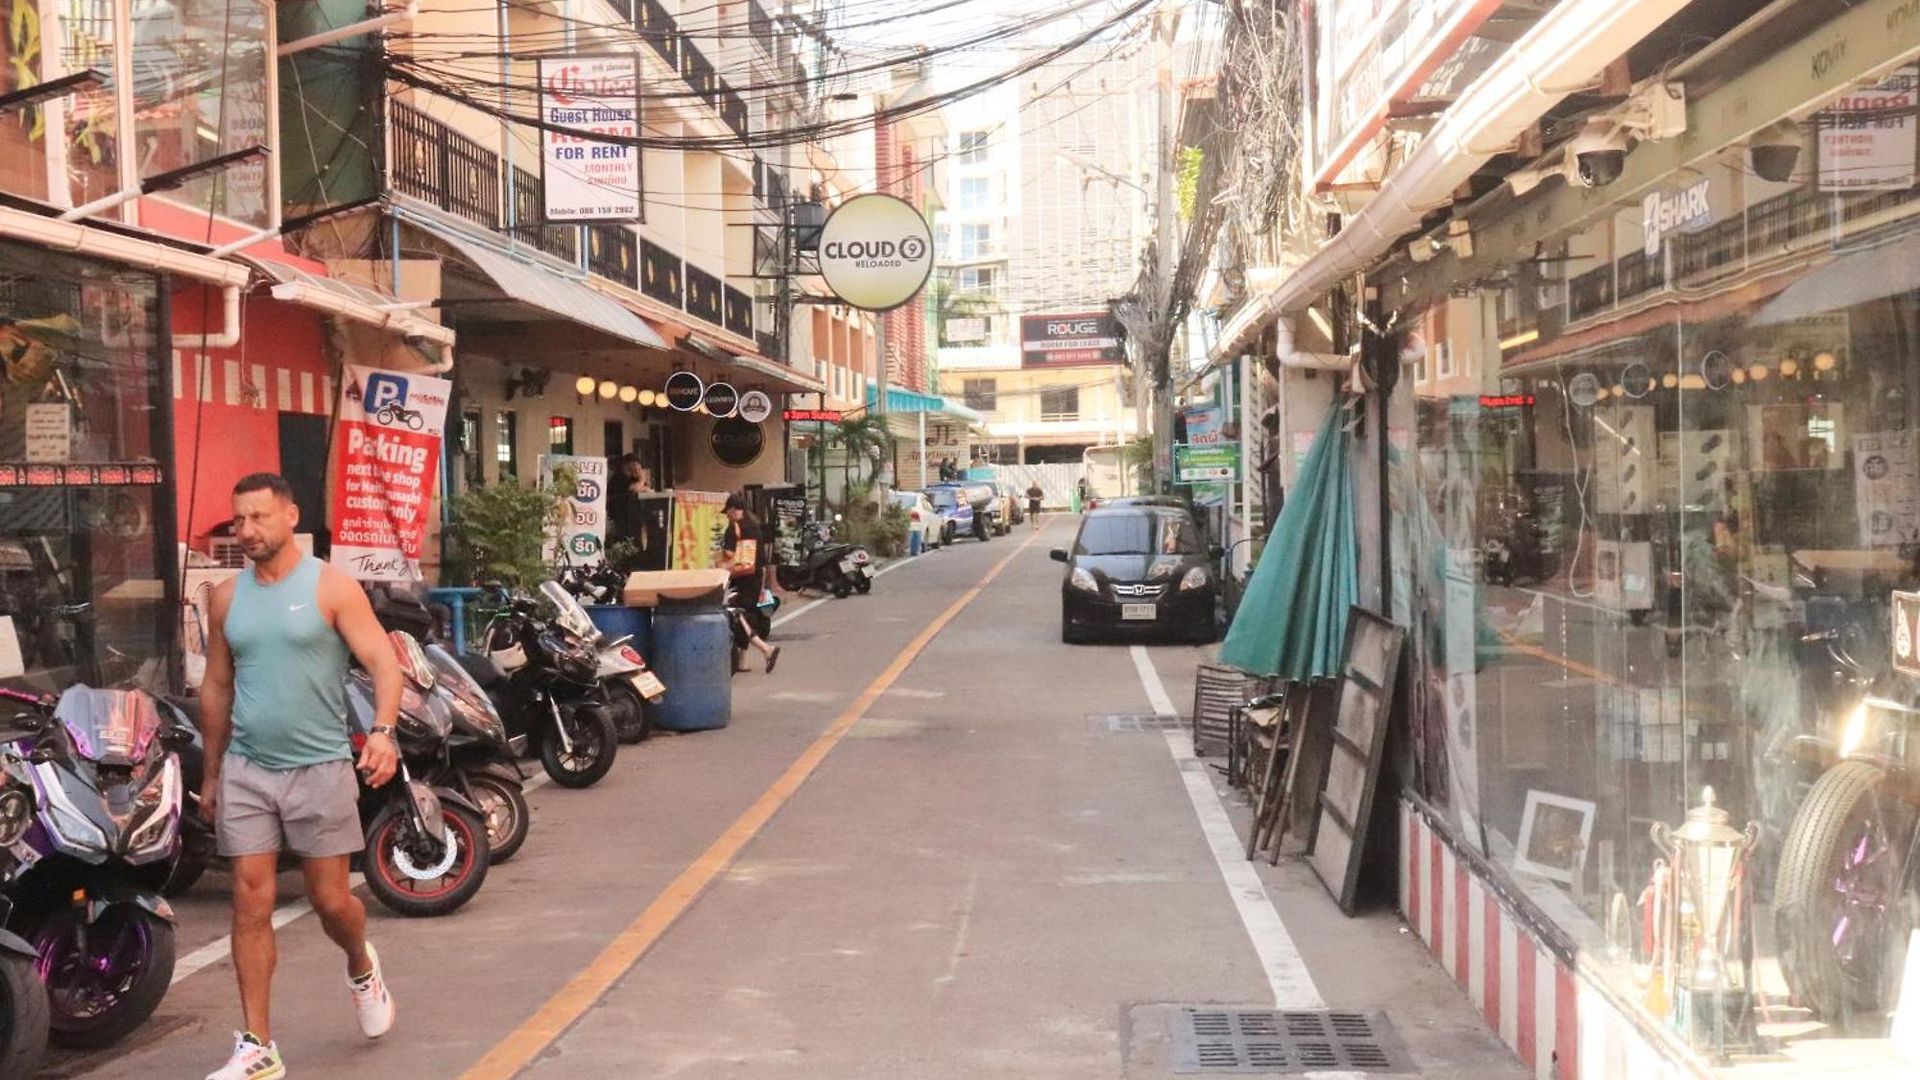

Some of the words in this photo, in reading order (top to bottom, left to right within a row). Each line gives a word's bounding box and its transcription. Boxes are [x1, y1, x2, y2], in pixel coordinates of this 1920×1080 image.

[551, 108, 588, 123] Guest
[592, 108, 632, 122] House
[556, 147, 584, 160] FOR
[592, 146, 629, 159] RENT
[585, 163, 633, 174] MONTHLY
[1660, 180, 1710, 232] SHARK
[825, 241, 895, 259] CLOUD
[856, 260, 902, 268] RELOADED
[1047, 322, 1098, 335] ROUGE
[374, 380, 399, 407] P
[347, 463, 372, 477] next
[393, 470, 421, 490] shop
